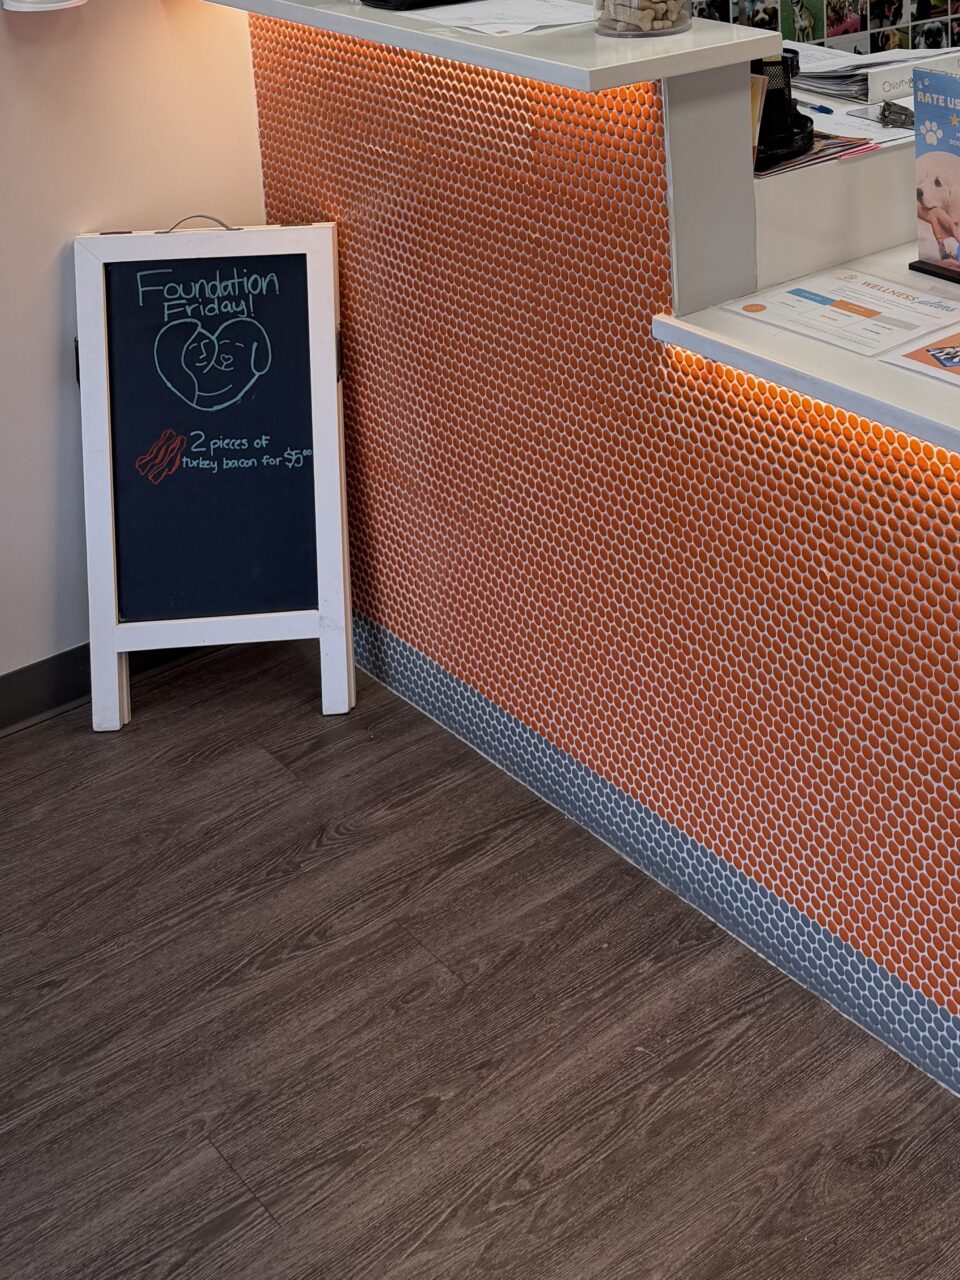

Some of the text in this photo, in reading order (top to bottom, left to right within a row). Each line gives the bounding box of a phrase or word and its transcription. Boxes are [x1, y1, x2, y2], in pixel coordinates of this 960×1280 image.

[883, 76, 914, 93] Overnig
[917, 91, 945, 107] RATE
[947, 97, 960, 110] US
[136, 267, 280, 306] Foundation
[861, 279, 919, 303] WELLNESS
[163, 294, 255, 321] Friday!
[190, 430, 271, 456] 2 pieces of
[182, 455, 218, 473] turkey
[222, 455, 257, 469] bacon
[261, 455, 282, 467] for
